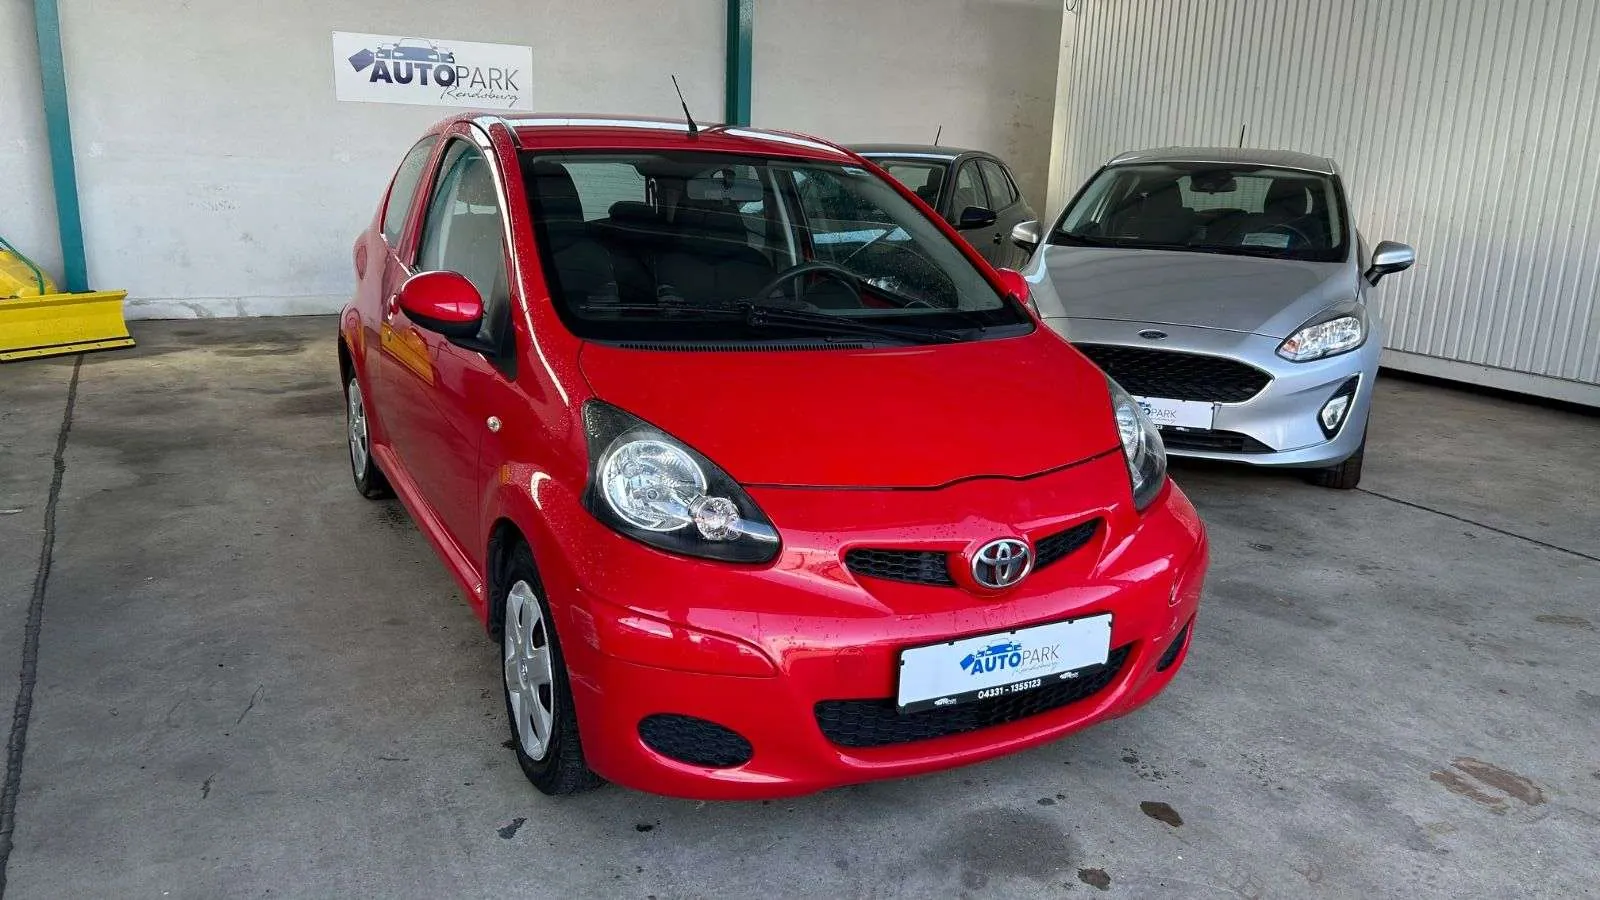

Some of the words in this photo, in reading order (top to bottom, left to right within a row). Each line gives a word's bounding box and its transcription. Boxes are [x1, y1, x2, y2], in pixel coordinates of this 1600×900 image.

[369, 60, 519, 91] AUTOPARK
[440, 84, 520, 108] Rendsburg
[1143, 407, 1176, 419] OPARK
[971, 644, 1060, 675] AUTOPARK
[978, 687, 1004, 699] 04331
[1010, 678, 1041, 692] 1355123
